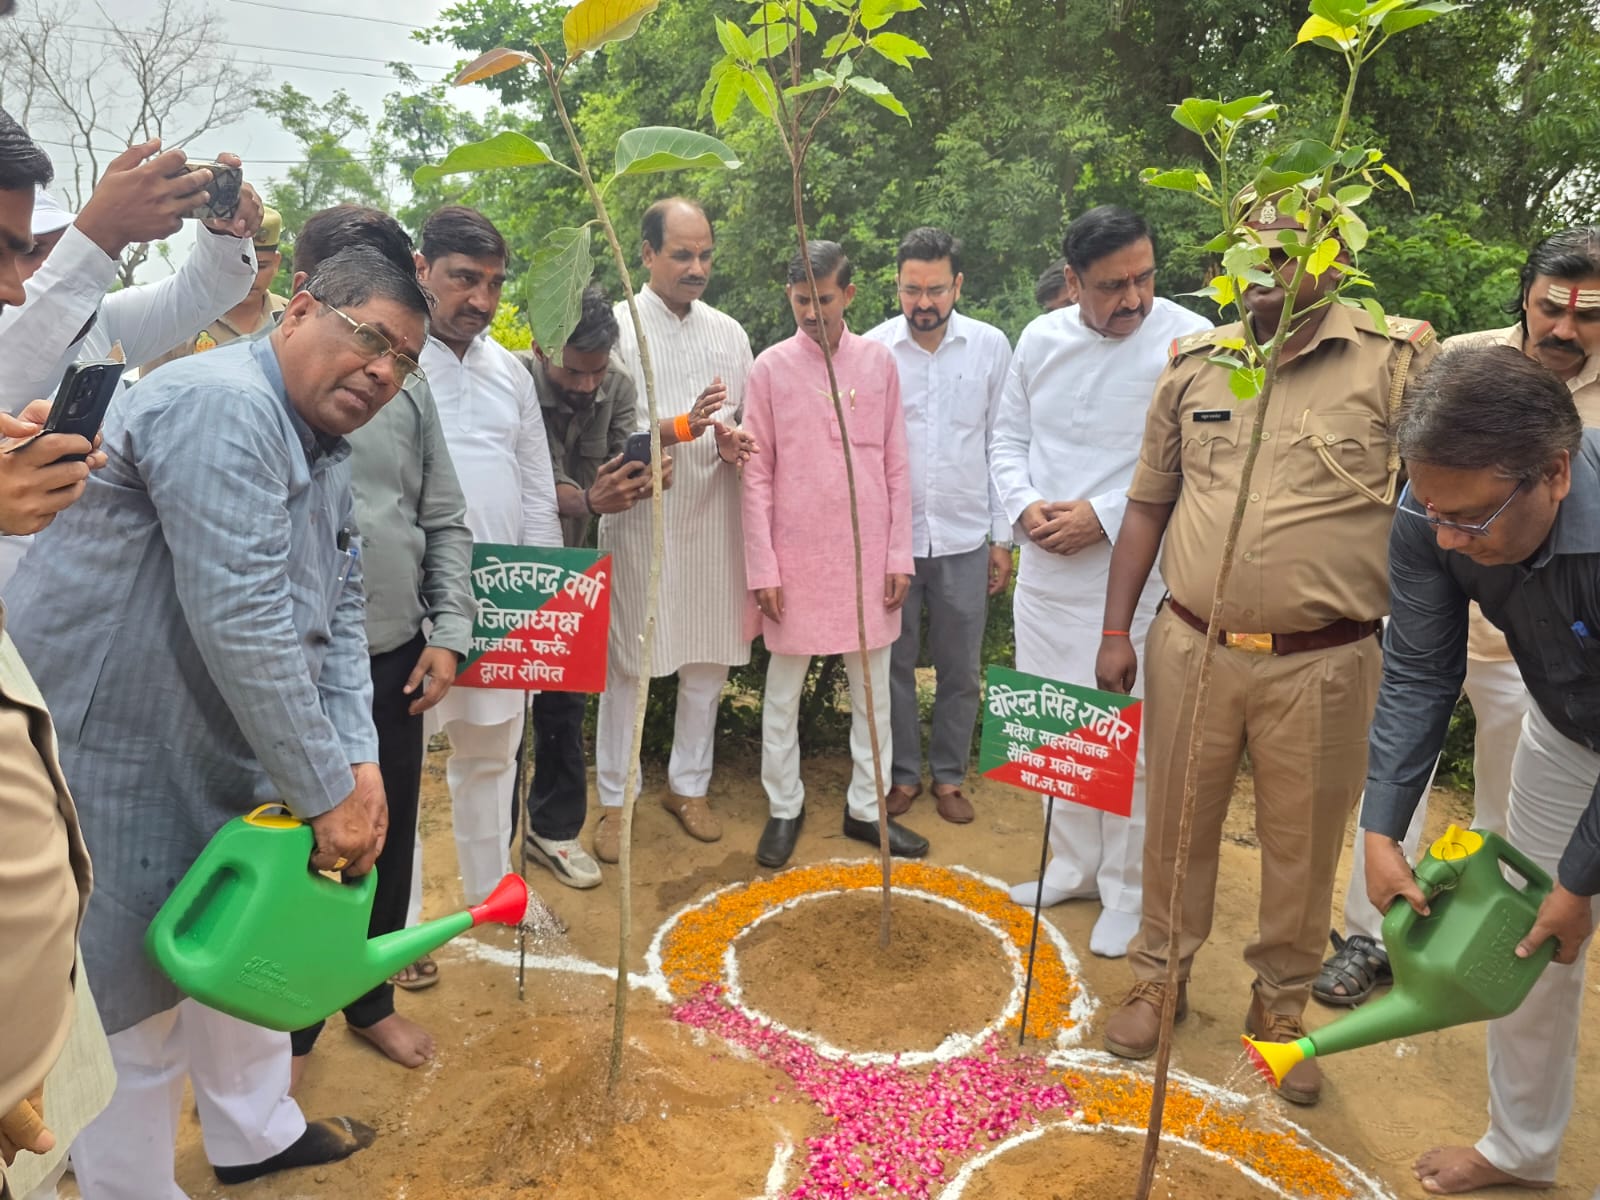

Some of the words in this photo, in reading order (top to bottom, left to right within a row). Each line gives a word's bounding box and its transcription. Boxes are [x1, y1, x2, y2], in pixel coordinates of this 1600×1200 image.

[563, 570, 607, 610] वर्मा
[477, 597, 584, 636] जिलाध्यक्ष
[480, 661, 516, 684] द्वारा
[517, 658, 565, 683] रोपित
[987, 684, 1040, 719] वीरेन्द्र
[1039, 683, 1079, 726] सिंह
[1002, 717, 1036, 742] प्रदेश
[1039, 731, 1109, 759] सहसंयोजक
[1006, 740, 1046, 769] सैनिक
